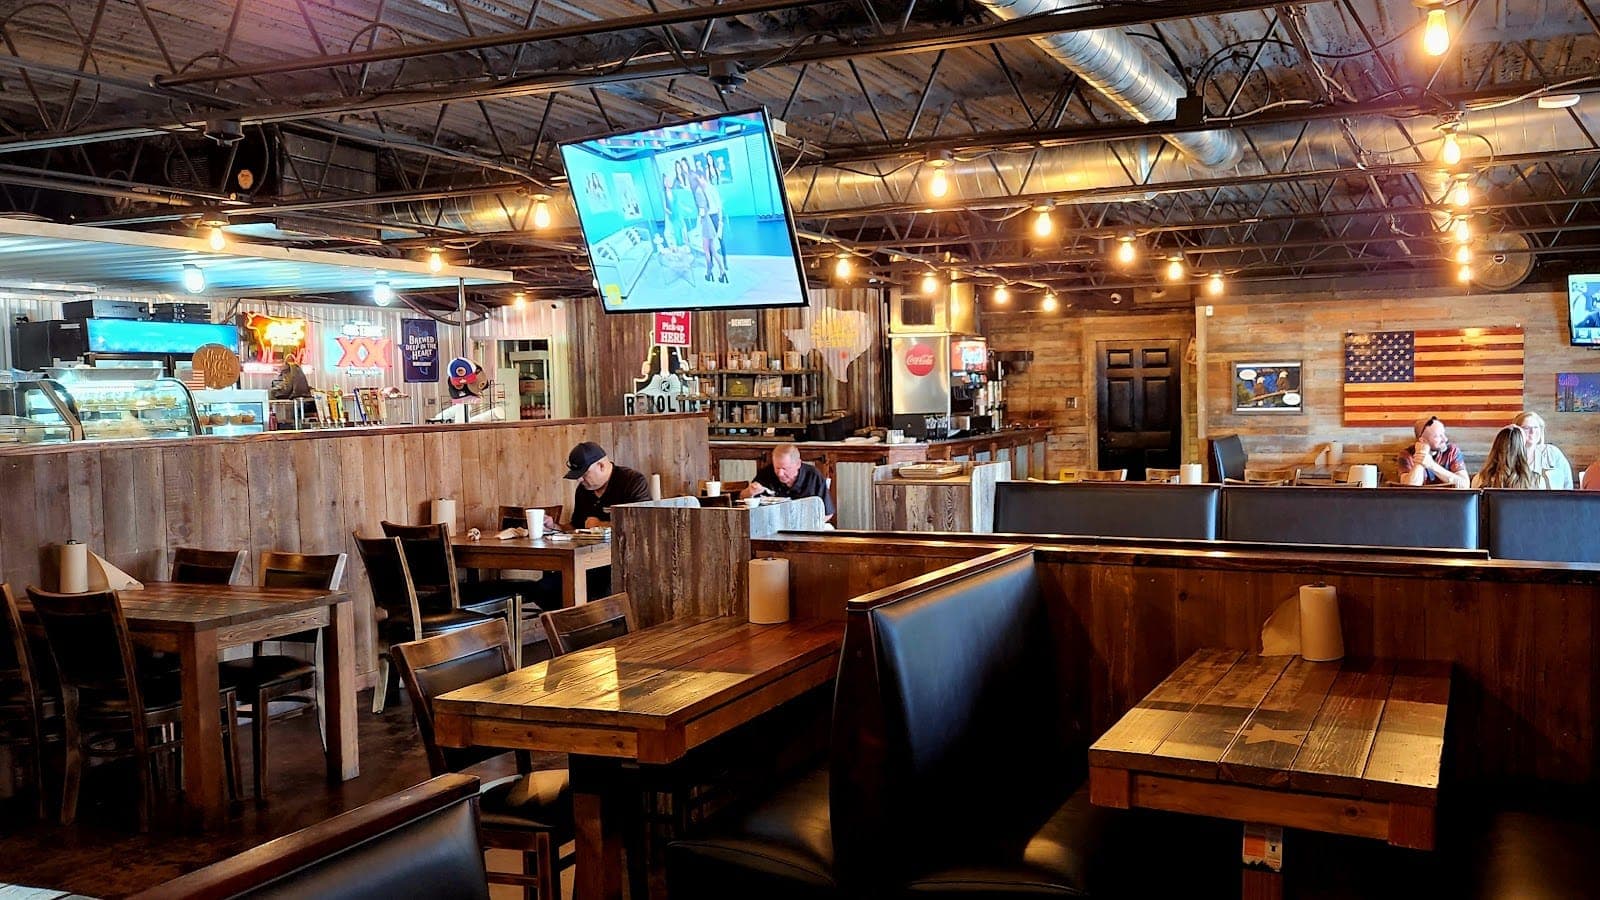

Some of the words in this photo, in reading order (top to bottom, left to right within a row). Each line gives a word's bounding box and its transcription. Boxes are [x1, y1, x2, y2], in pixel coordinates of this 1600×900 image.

[409, 335, 435, 345] BREWED
[660, 331, 686, 344] HERE
[336, 336, 392, 368] XX
[405, 343, 420, 351] DEEP
[412, 349, 433, 361] HEART
